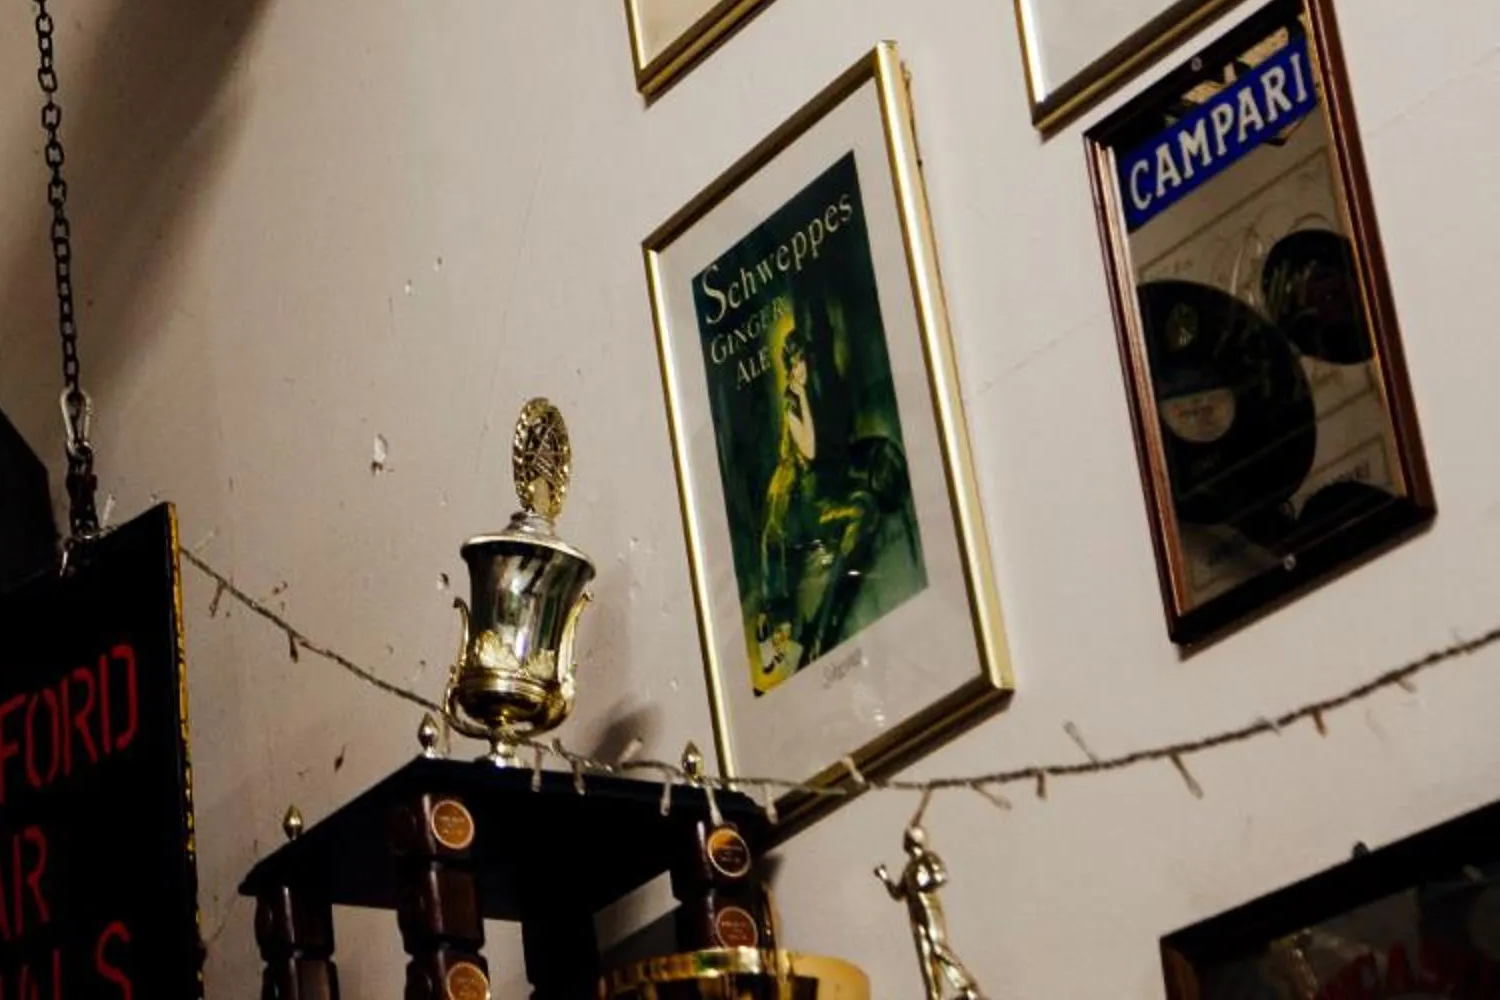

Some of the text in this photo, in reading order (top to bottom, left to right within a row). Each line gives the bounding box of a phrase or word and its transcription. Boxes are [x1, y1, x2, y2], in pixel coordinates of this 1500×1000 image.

[1128, 51, 1309, 212] CAMPARI
[702, 194, 854, 326] Schweppes
[710, 296, 785, 364] GINGER
[735, 346, 772, 391] ALE
